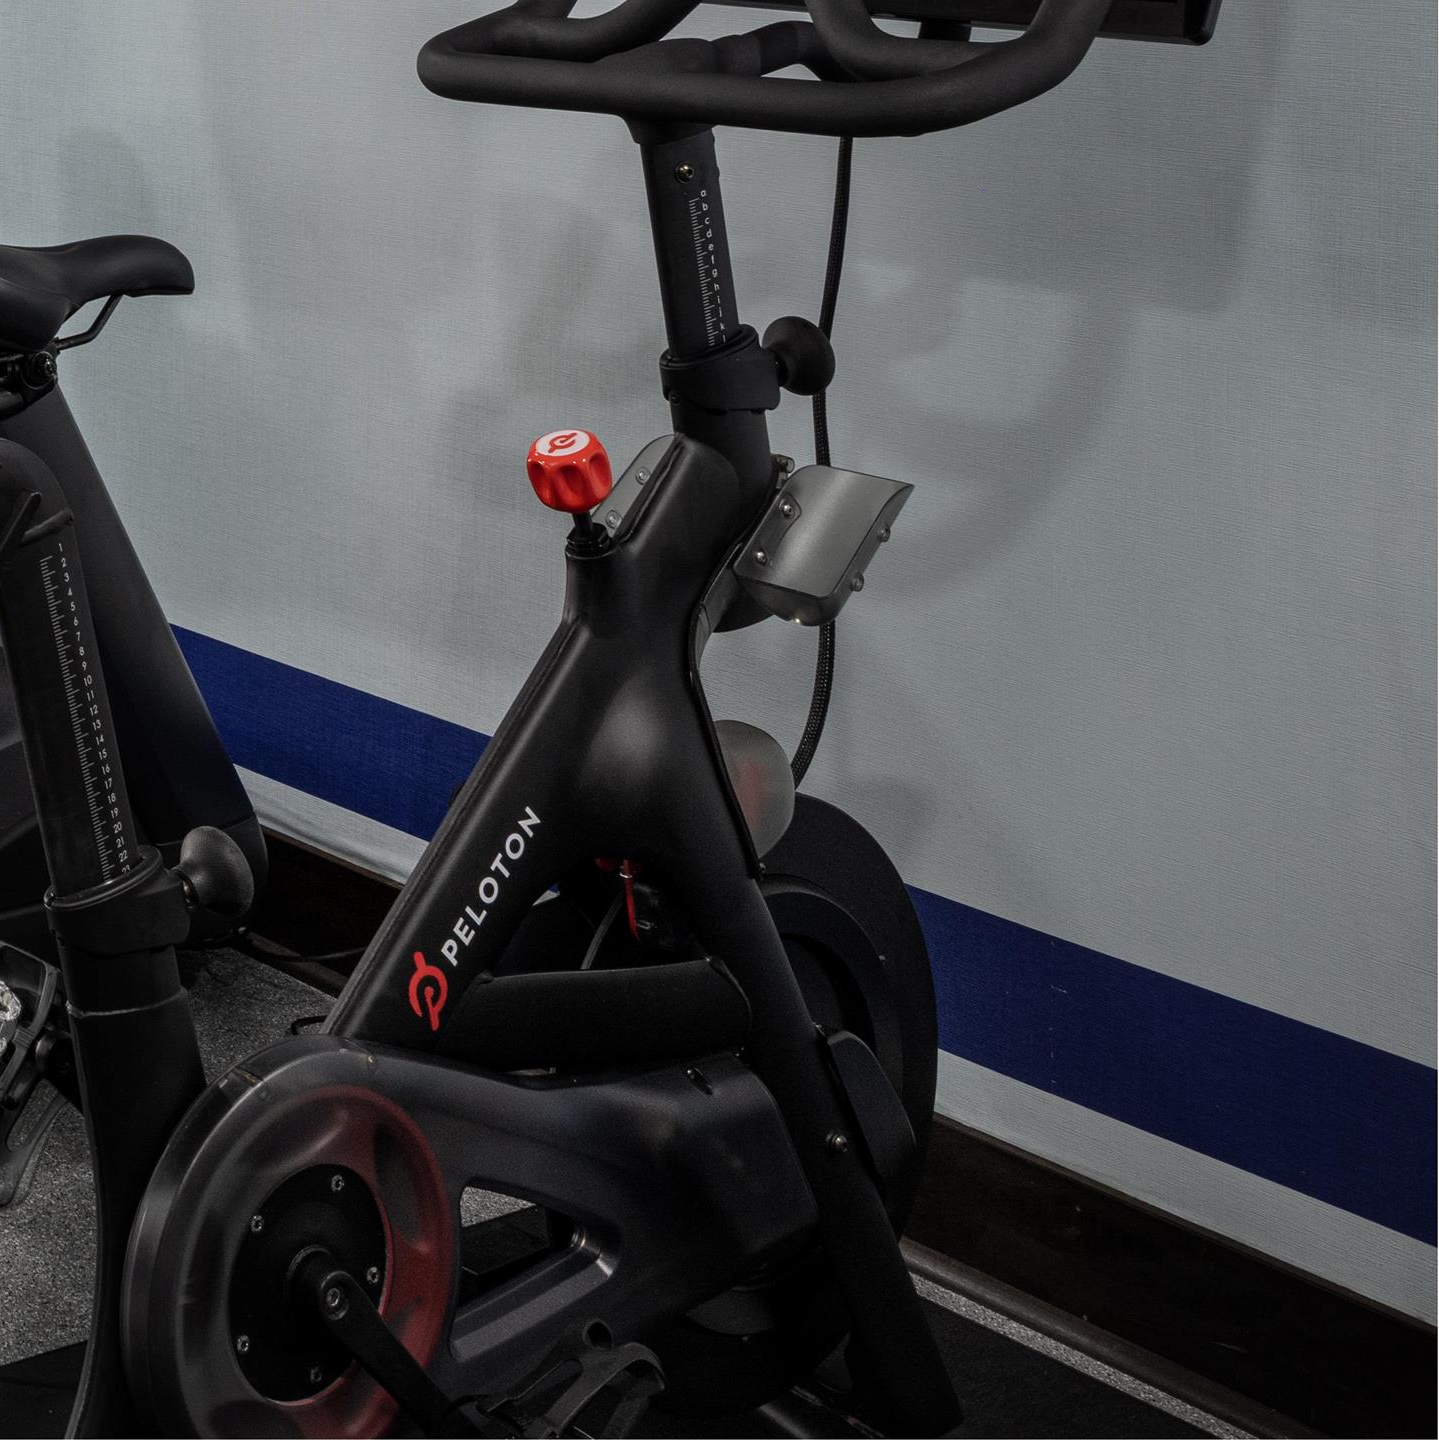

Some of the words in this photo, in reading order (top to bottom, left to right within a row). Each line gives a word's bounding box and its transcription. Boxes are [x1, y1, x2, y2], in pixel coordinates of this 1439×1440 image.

[84, 674, 93, 686] 10
[87, 689, 95, 700] 11
[90, 704, 99, 715] 12
[93, 719, 102, 730] 13
[96, 734, 105, 745] 14
[99, 748, 108, 759] 15
[102, 763, 111, 774] 16
[105, 777, 113, 789] 17
[108, 792, 116, 803] 18
[111, 807, 119, 818] 19
[113, 821, 123, 833] 20
[116, 836, 125, 848] 21
[119, 849, 128, 862] 22
[441, 806, 541, 967] PELOTON
